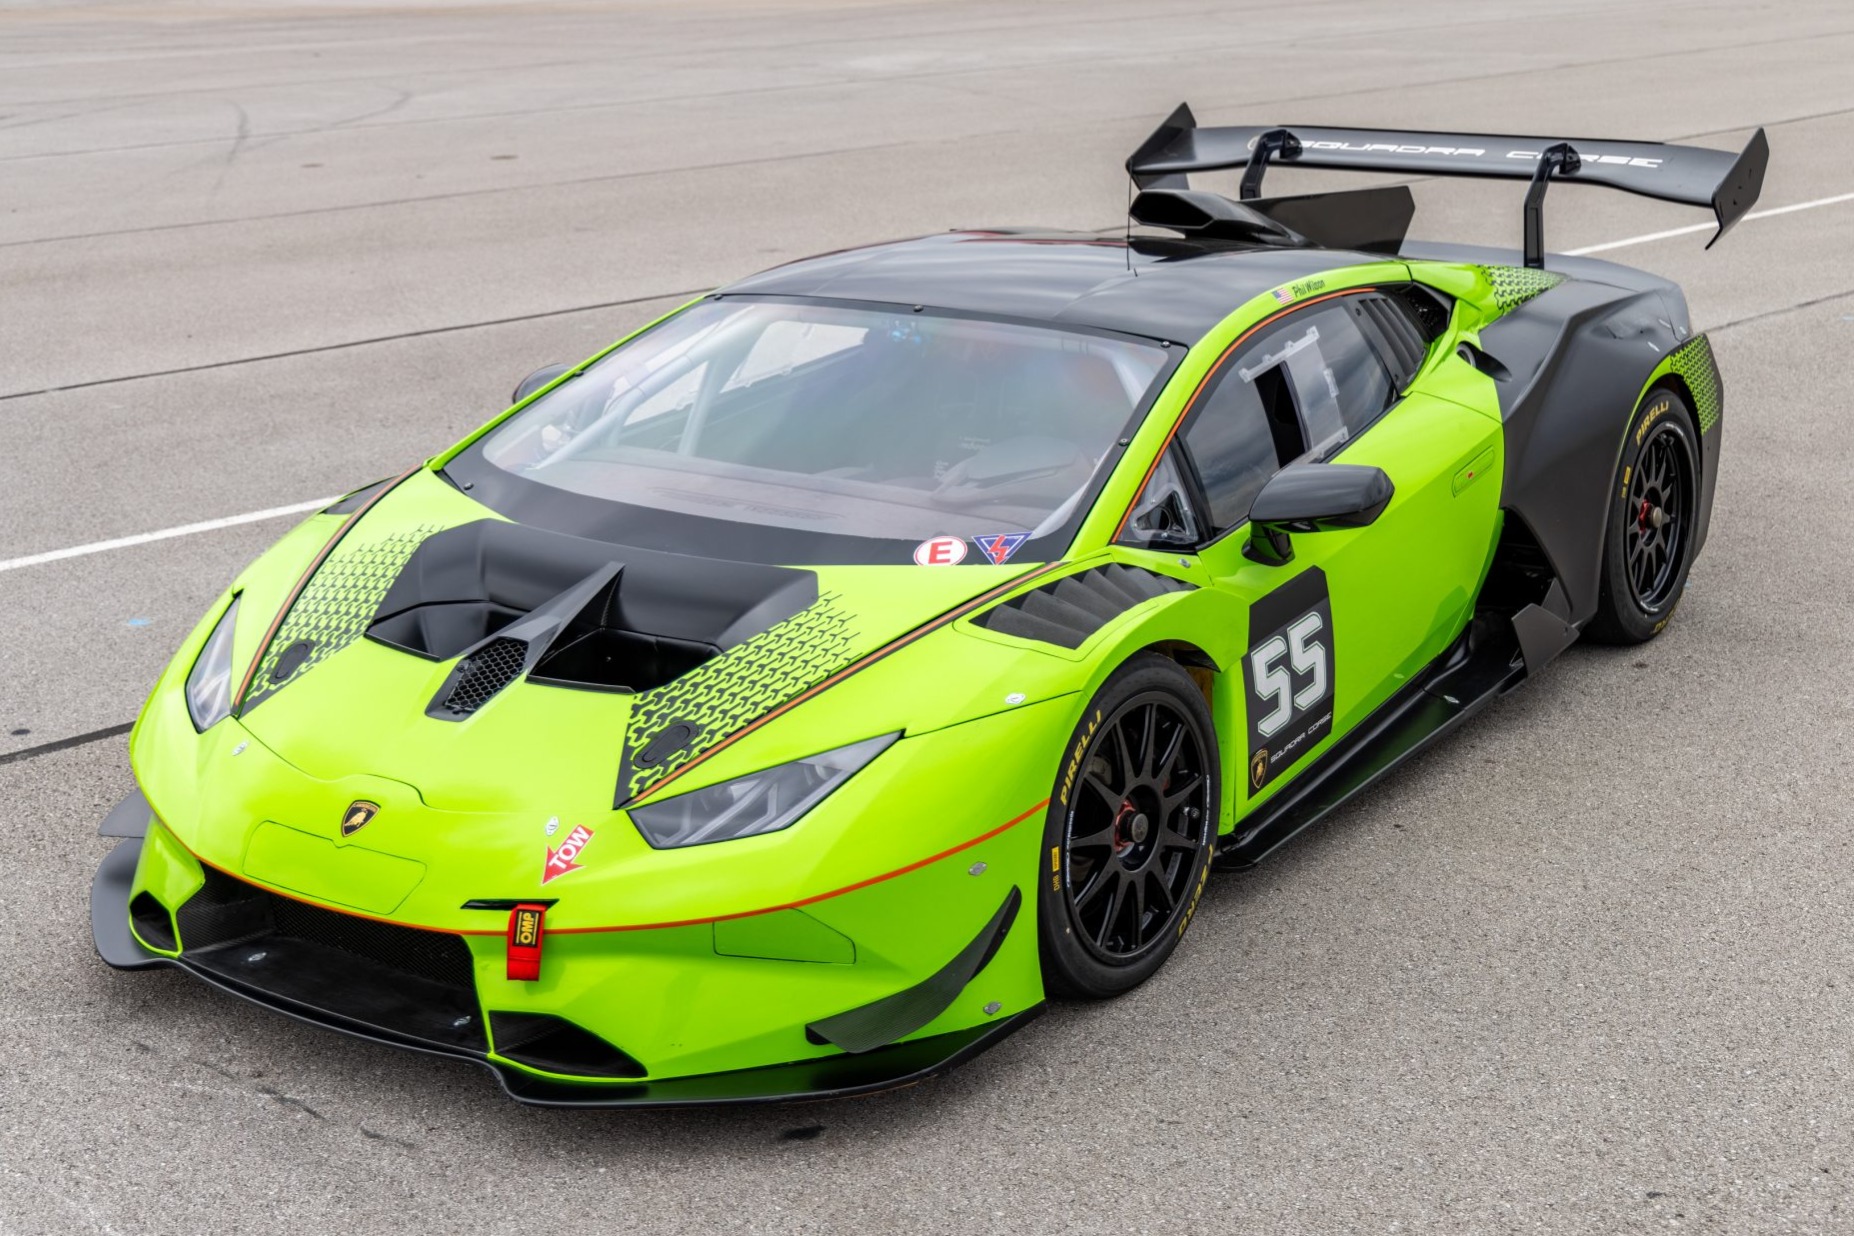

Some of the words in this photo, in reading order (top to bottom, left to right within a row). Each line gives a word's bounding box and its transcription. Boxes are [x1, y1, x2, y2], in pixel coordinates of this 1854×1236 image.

[1505, 150, 1664, 169] CRSE
[1636, 400, 1670, 448] PIRELLI
[928, 541, 953, 564] E
[1250, 611, 1327, 738] 55
[1060, 709, 1101, 806] PIRELLI
[1270, 732, 1307, 764] SQUADRA
[1307, 711, 1333, 735] CORSE
[548, 826, 590, 870] TOW
[520, 912, 535, 944] OMP
